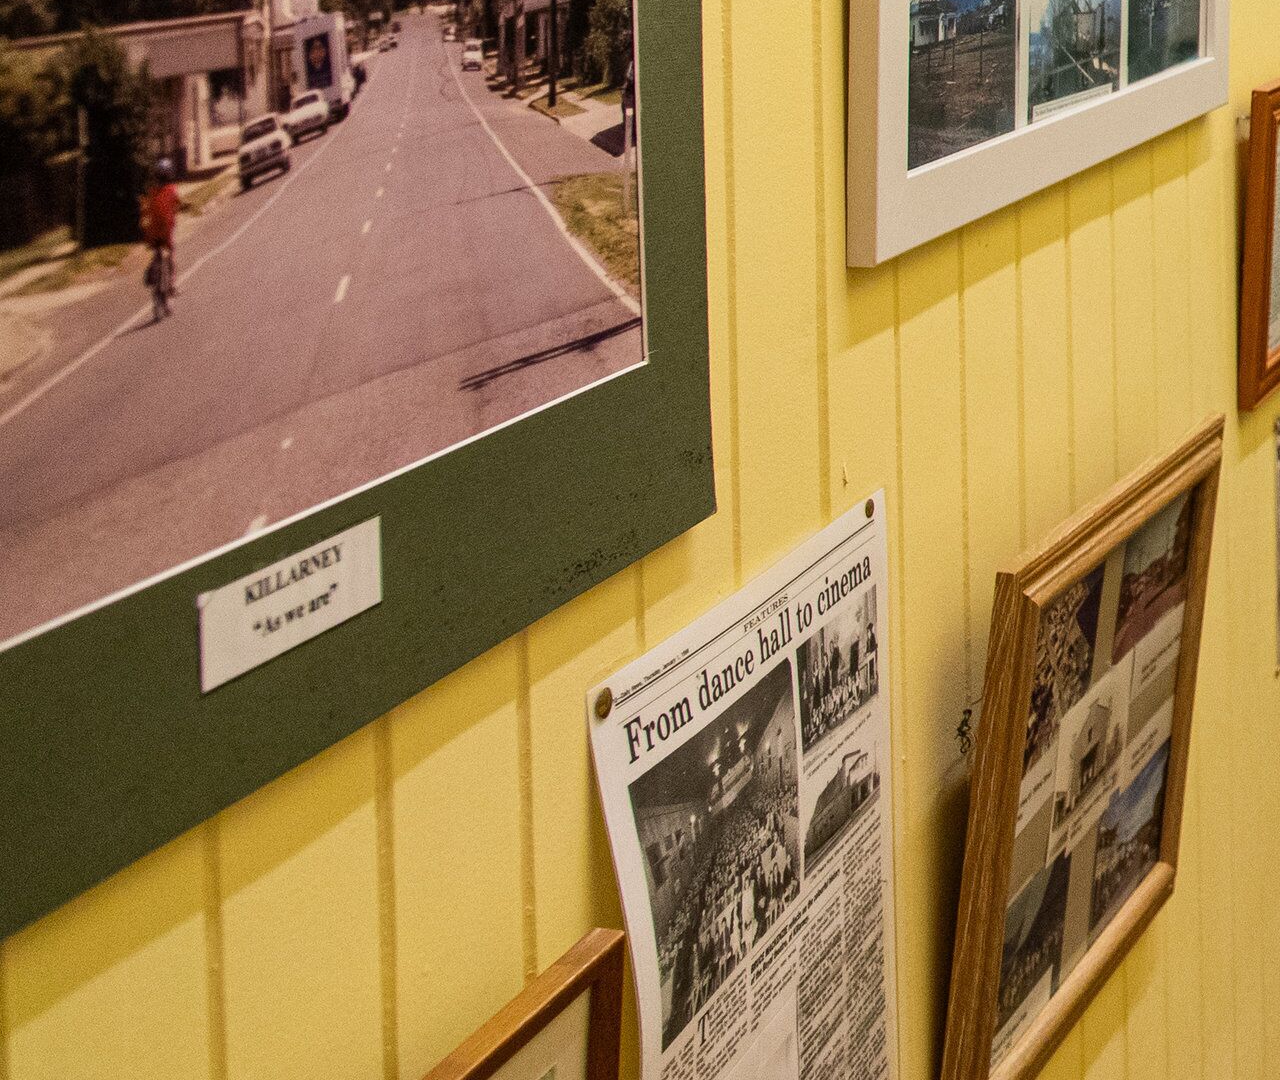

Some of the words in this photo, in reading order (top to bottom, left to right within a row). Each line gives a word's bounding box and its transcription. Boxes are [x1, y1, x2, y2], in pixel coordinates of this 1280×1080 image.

[245, 543, 343, 604] KILLARNEY
[284, 604, 304, 623] we
[743, 593, 789, 633] FEATURES
[623, 696, 694, 765] From
[698, 649, 754, 711] dance
[757, 608, 792, 665] hall
[797, 602, 812, 634] to
[817, 555, 872, 616] cinema
